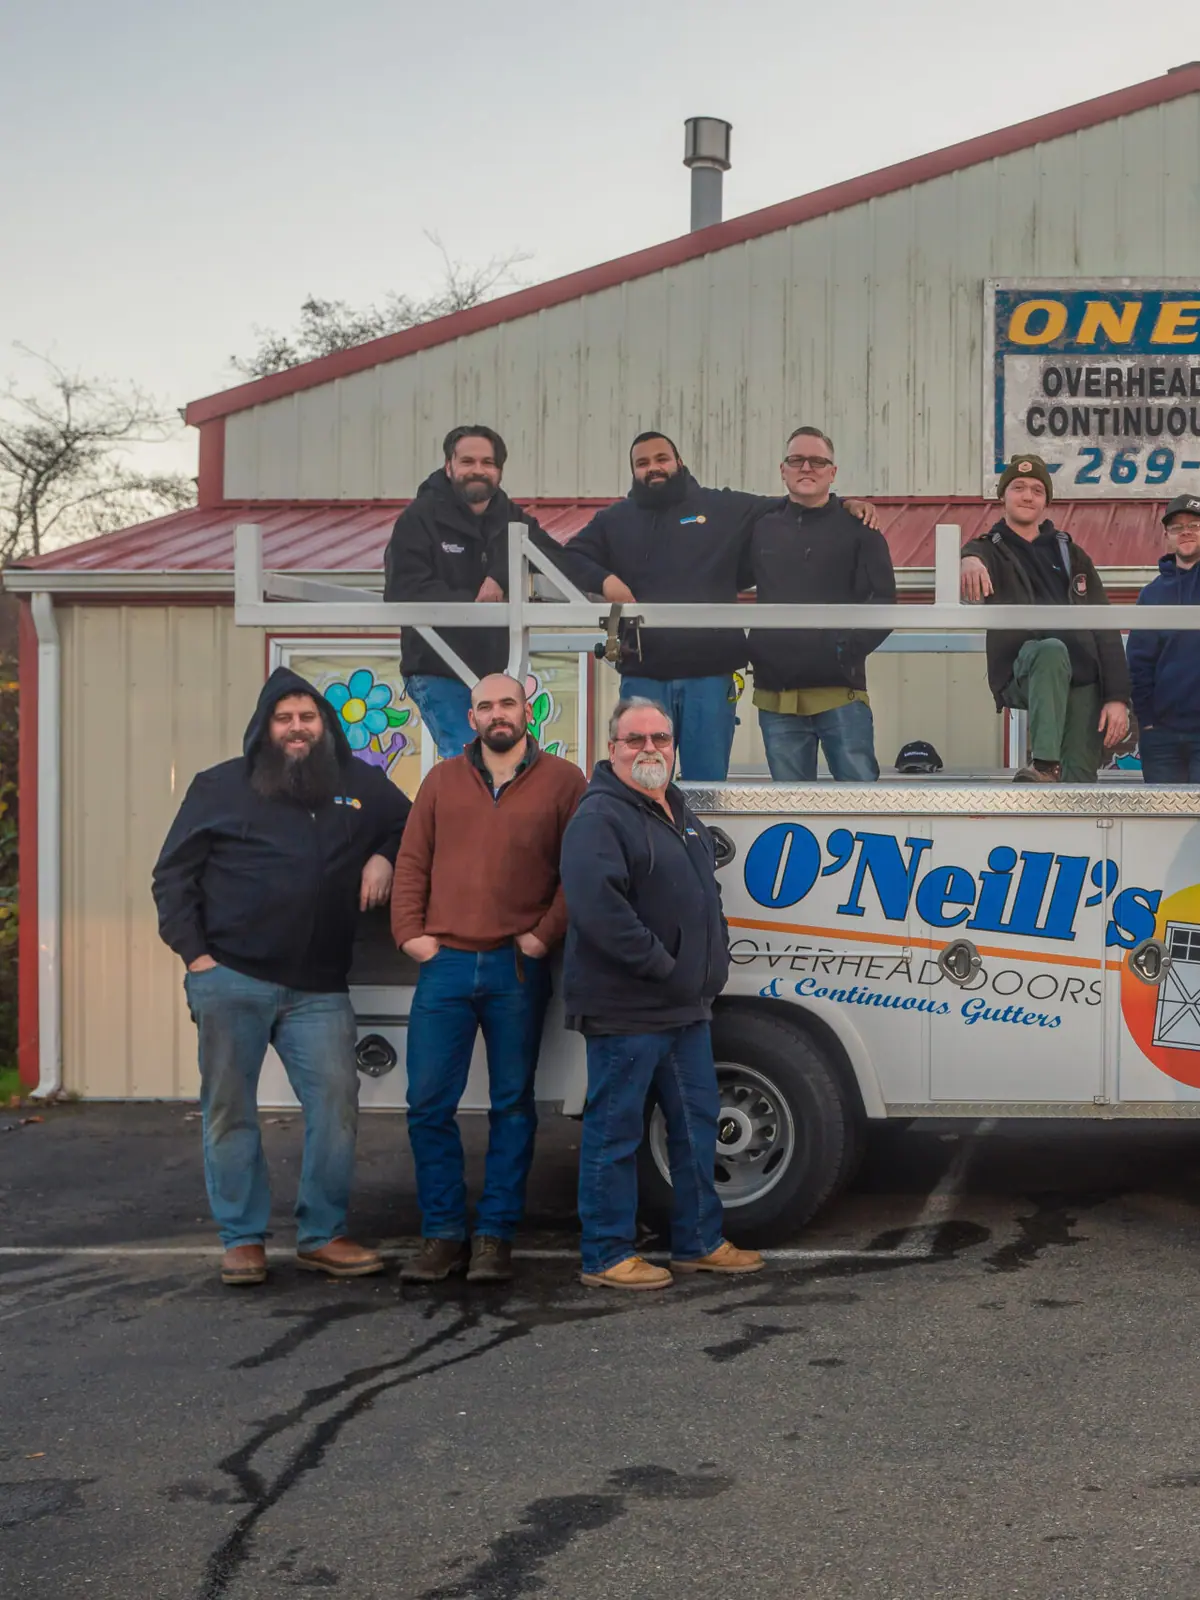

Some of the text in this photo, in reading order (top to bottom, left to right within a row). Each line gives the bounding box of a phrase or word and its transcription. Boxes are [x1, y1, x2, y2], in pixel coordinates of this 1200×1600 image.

[743, 822, 1163, 950] O'Neill's
[728, 938, 945, 986] OVERHEAD
[794, 976, 951, 1015] Continuous
[961, 997, 1062, 1029] Gutters
